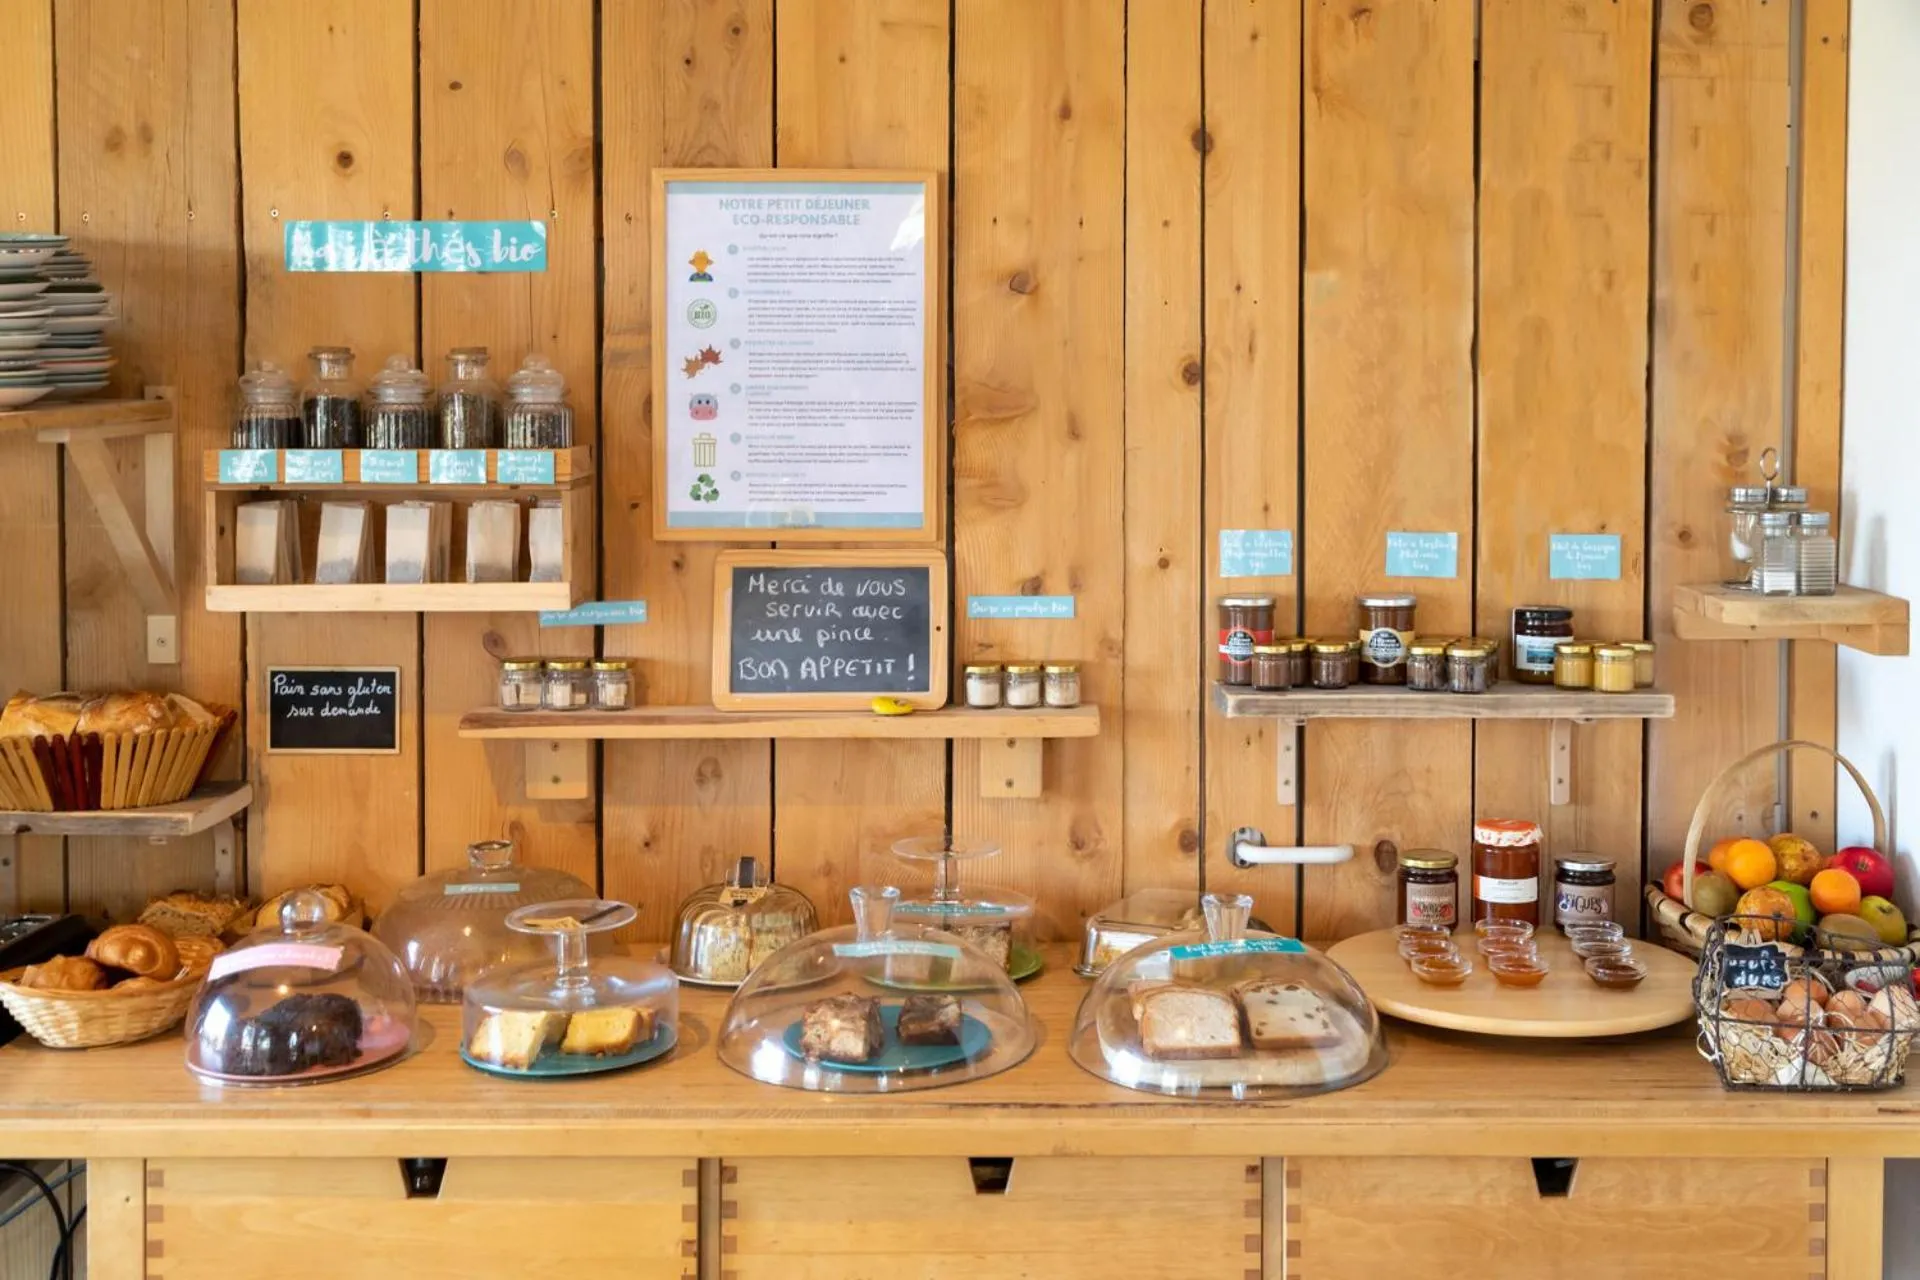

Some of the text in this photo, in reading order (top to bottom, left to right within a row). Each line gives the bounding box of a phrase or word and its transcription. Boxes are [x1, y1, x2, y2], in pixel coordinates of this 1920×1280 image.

[719, 197, 870, 210] NOTRE PETIT DÉJEUNER
[733, 214, 860, 226] ECO-RESPONSABLE
[490, 228, 542, 264] bio
[748, 573, 810, 596] Merci
[820, 577, 844, 597] de
[851, 604, 903, 620] avec
[750, 626, 804, 644] une
[800, 655, 897, 681] APPETIT
[906, 652, 916, 681] !
[273, 673, 393, 708] Pain sans gluten
[286, 698, 381, 719] sur demande
